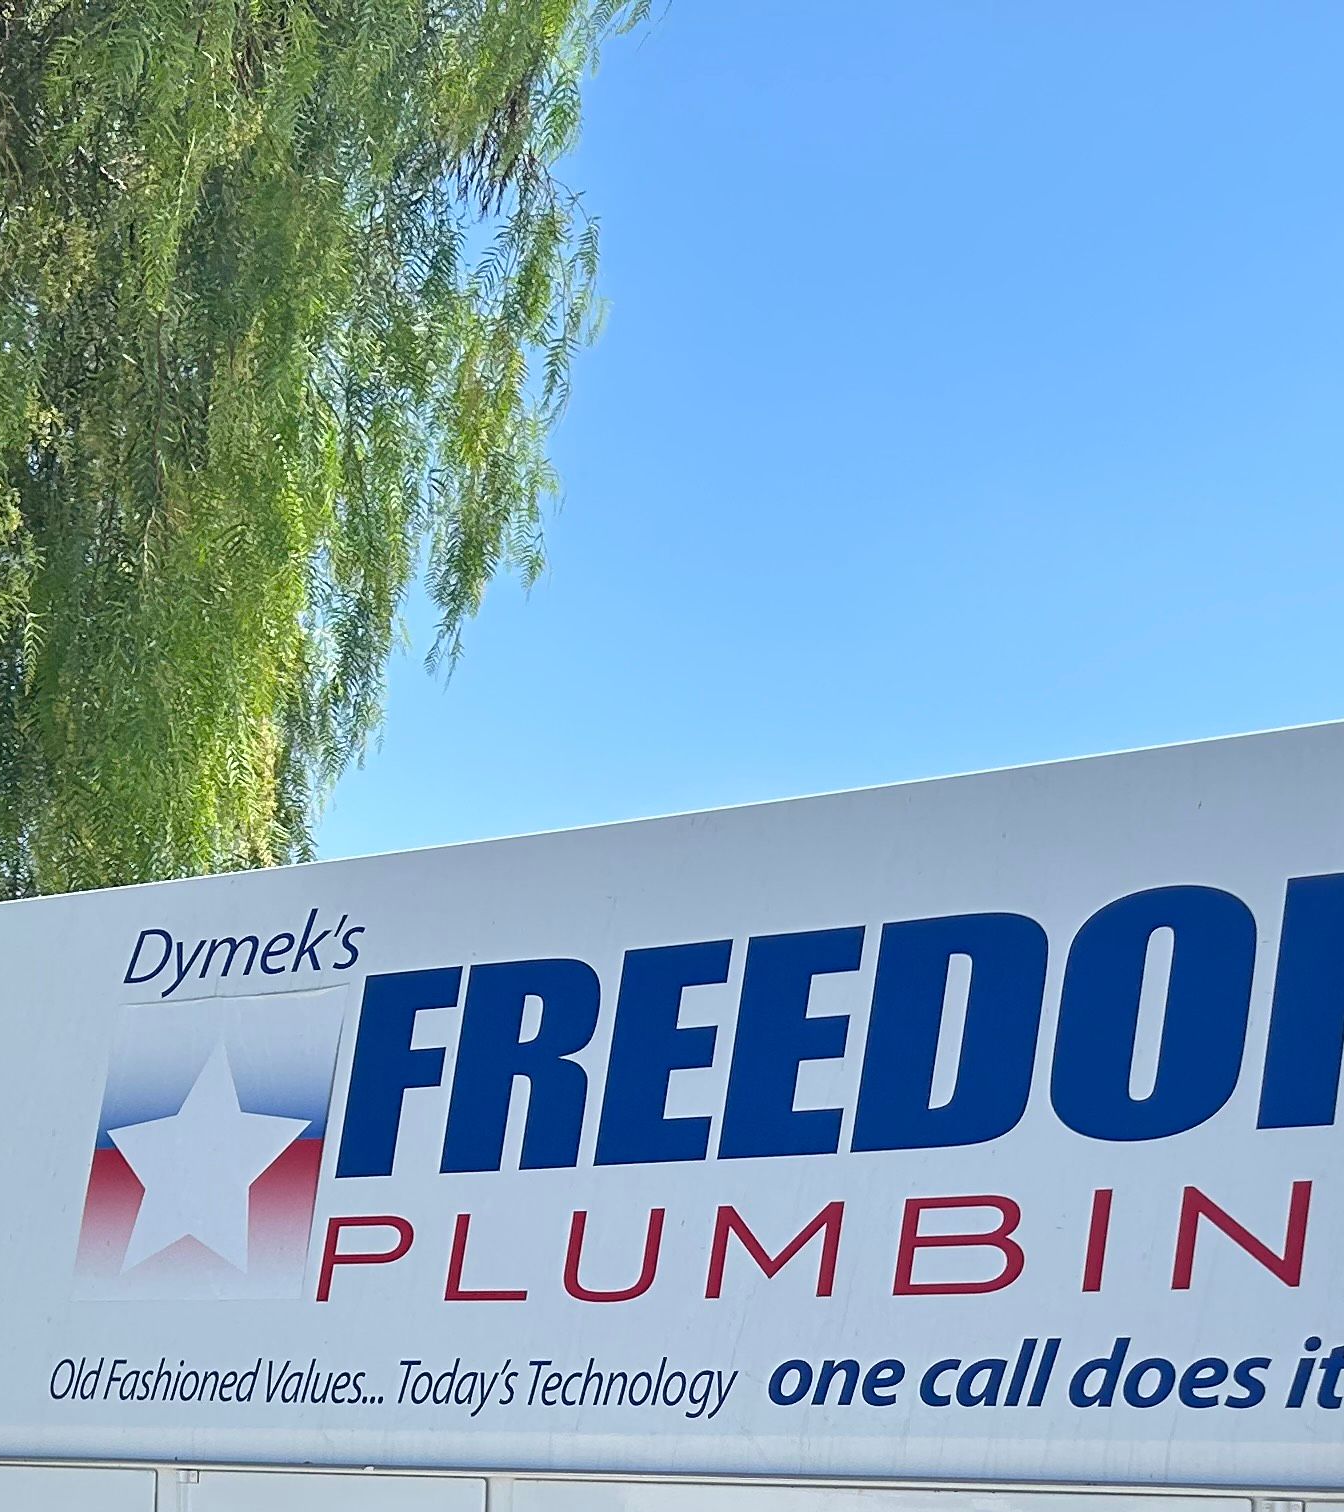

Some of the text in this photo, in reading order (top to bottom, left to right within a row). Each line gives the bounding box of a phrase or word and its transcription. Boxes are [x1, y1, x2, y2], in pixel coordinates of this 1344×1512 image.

[123, 908, 365, 998] Dymek's
[50, 1357, 105, 1400] Old
[103, 1357, 262, 1401] Fashioned
[265, 1358, 384, 1404] Values...
[397, 1358, 519, 1417] Today's
[527, 1357, 738, 1419] Technology
[768, 1358, 906, 1407] one
[919, 1338, 1062, 1407] call
[1069, 1337, 1272, 1409] does
